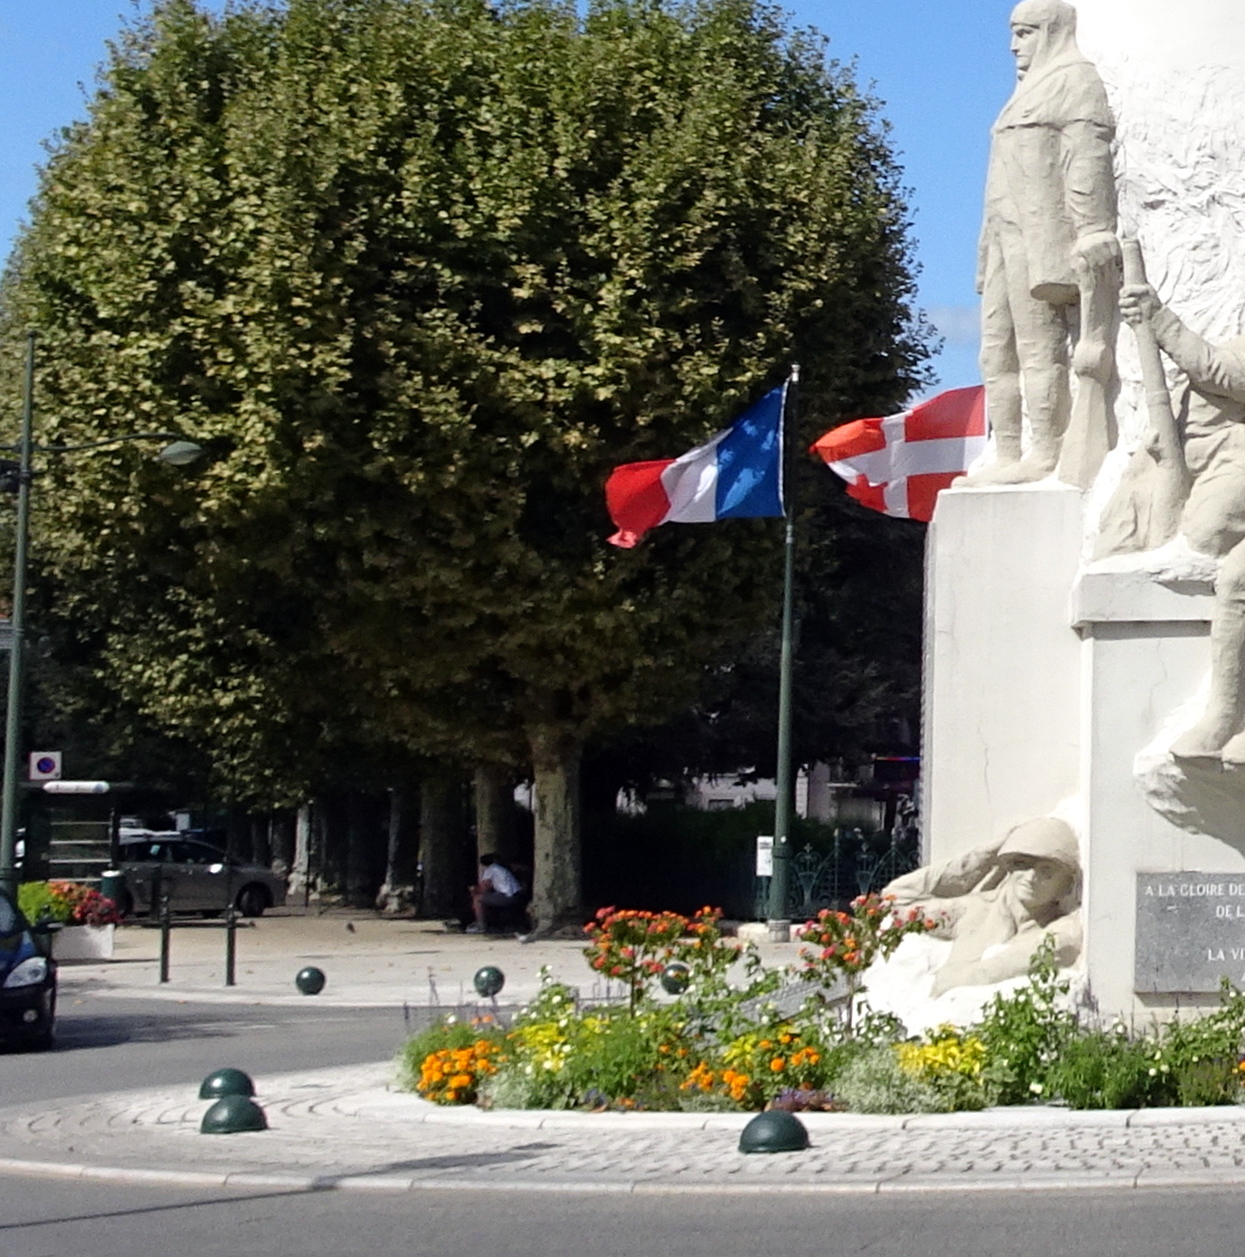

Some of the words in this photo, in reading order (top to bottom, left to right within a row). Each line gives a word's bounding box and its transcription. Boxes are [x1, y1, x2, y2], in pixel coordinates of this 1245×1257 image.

[1145, 884, 1154, 896] A
[1159, 884, 1175, 896] LA
[1180, 883, 1225, 896] GLOIRE
[1216, 905, 1233, 917] DE
[1208, 948, 1225, 961] LA
